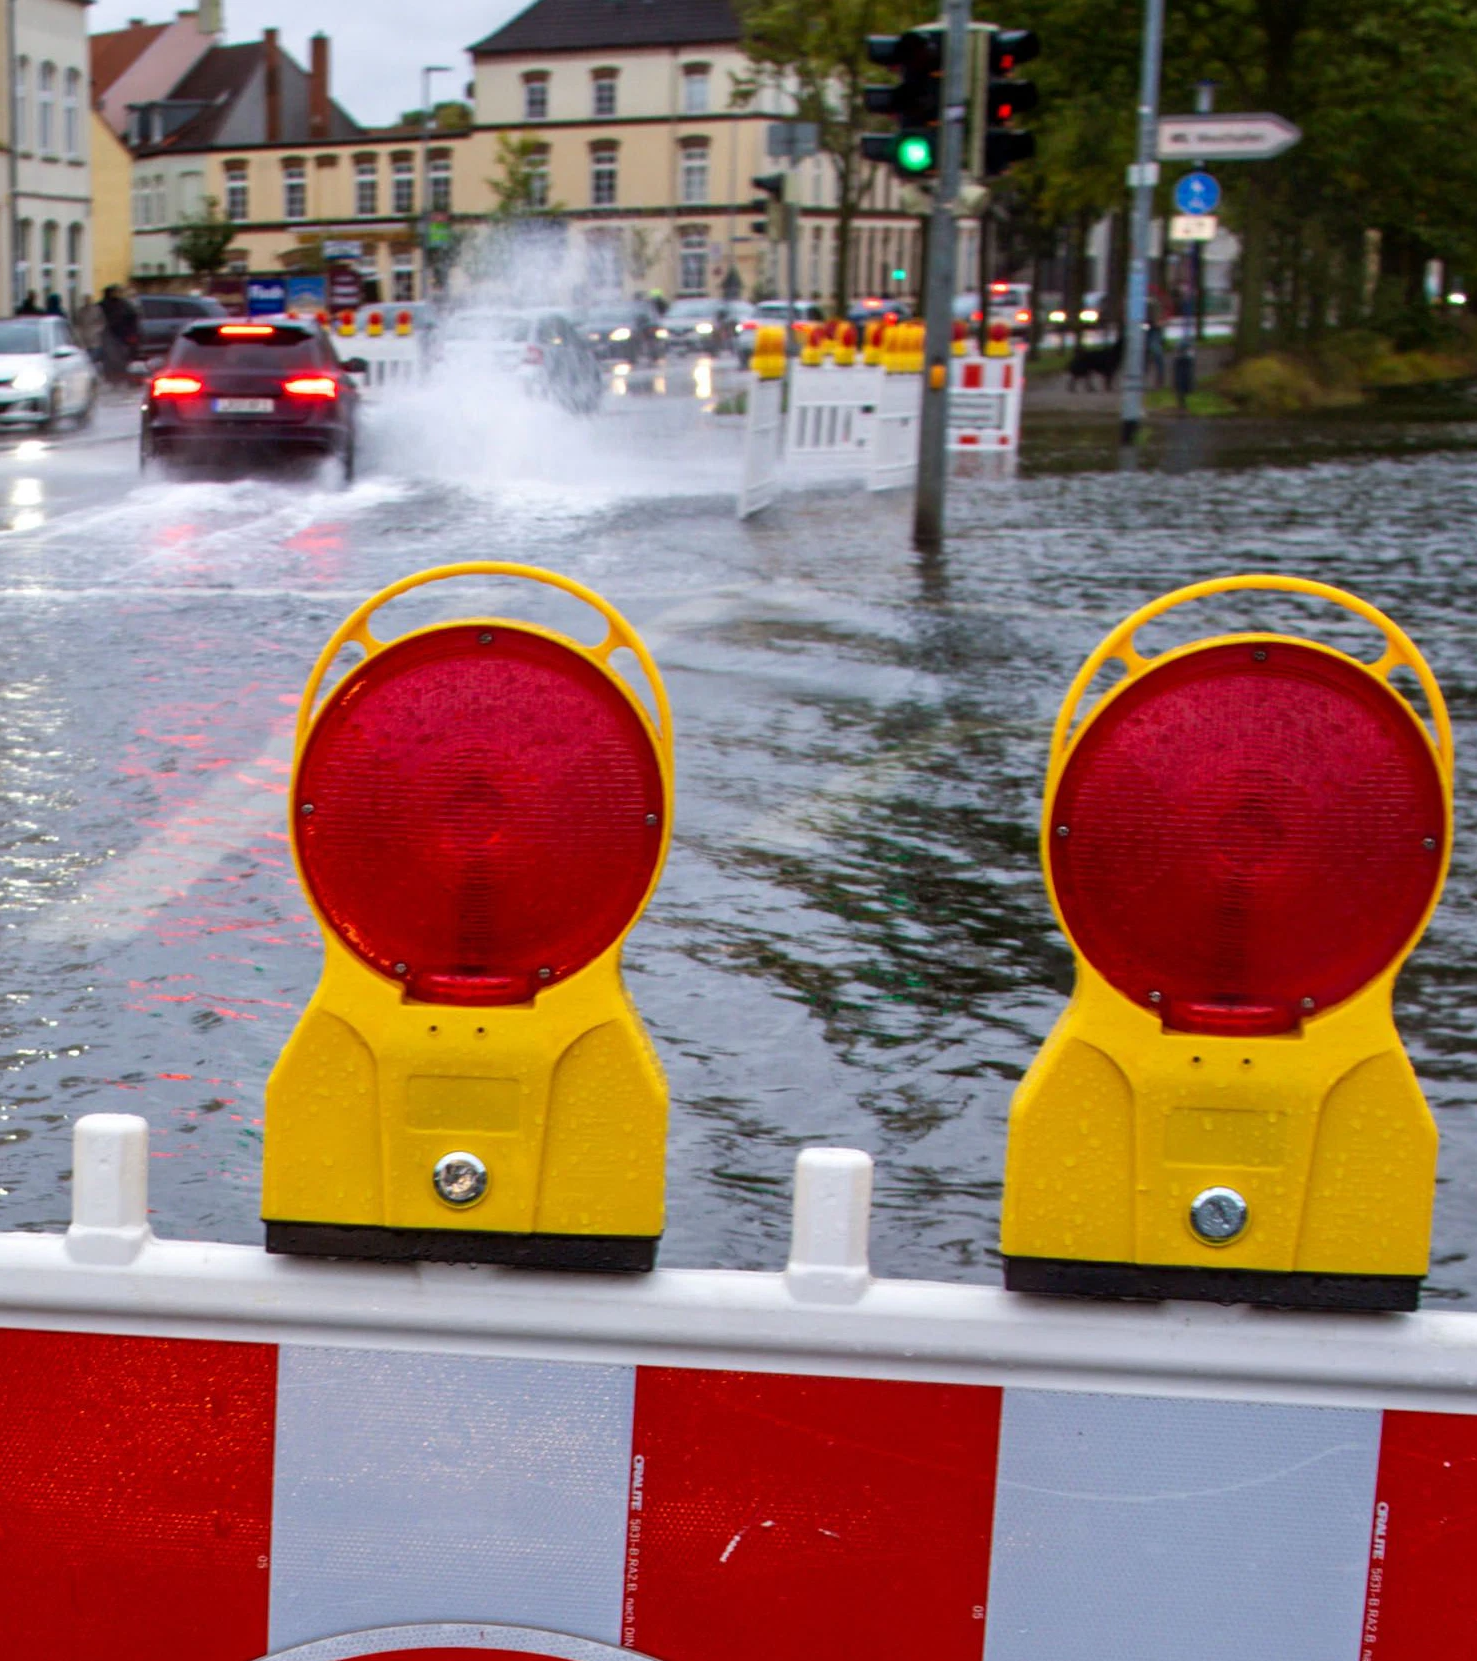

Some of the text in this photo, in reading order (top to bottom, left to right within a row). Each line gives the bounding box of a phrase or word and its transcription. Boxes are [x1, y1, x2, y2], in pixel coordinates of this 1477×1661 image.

[631, 1454, 645, 1510] ORALITE
[1373, 1502, 1389, 1560] ORALITE
[625, 1598, 635, 1624] nach
[623, 1626, 635, 1648] DIN
